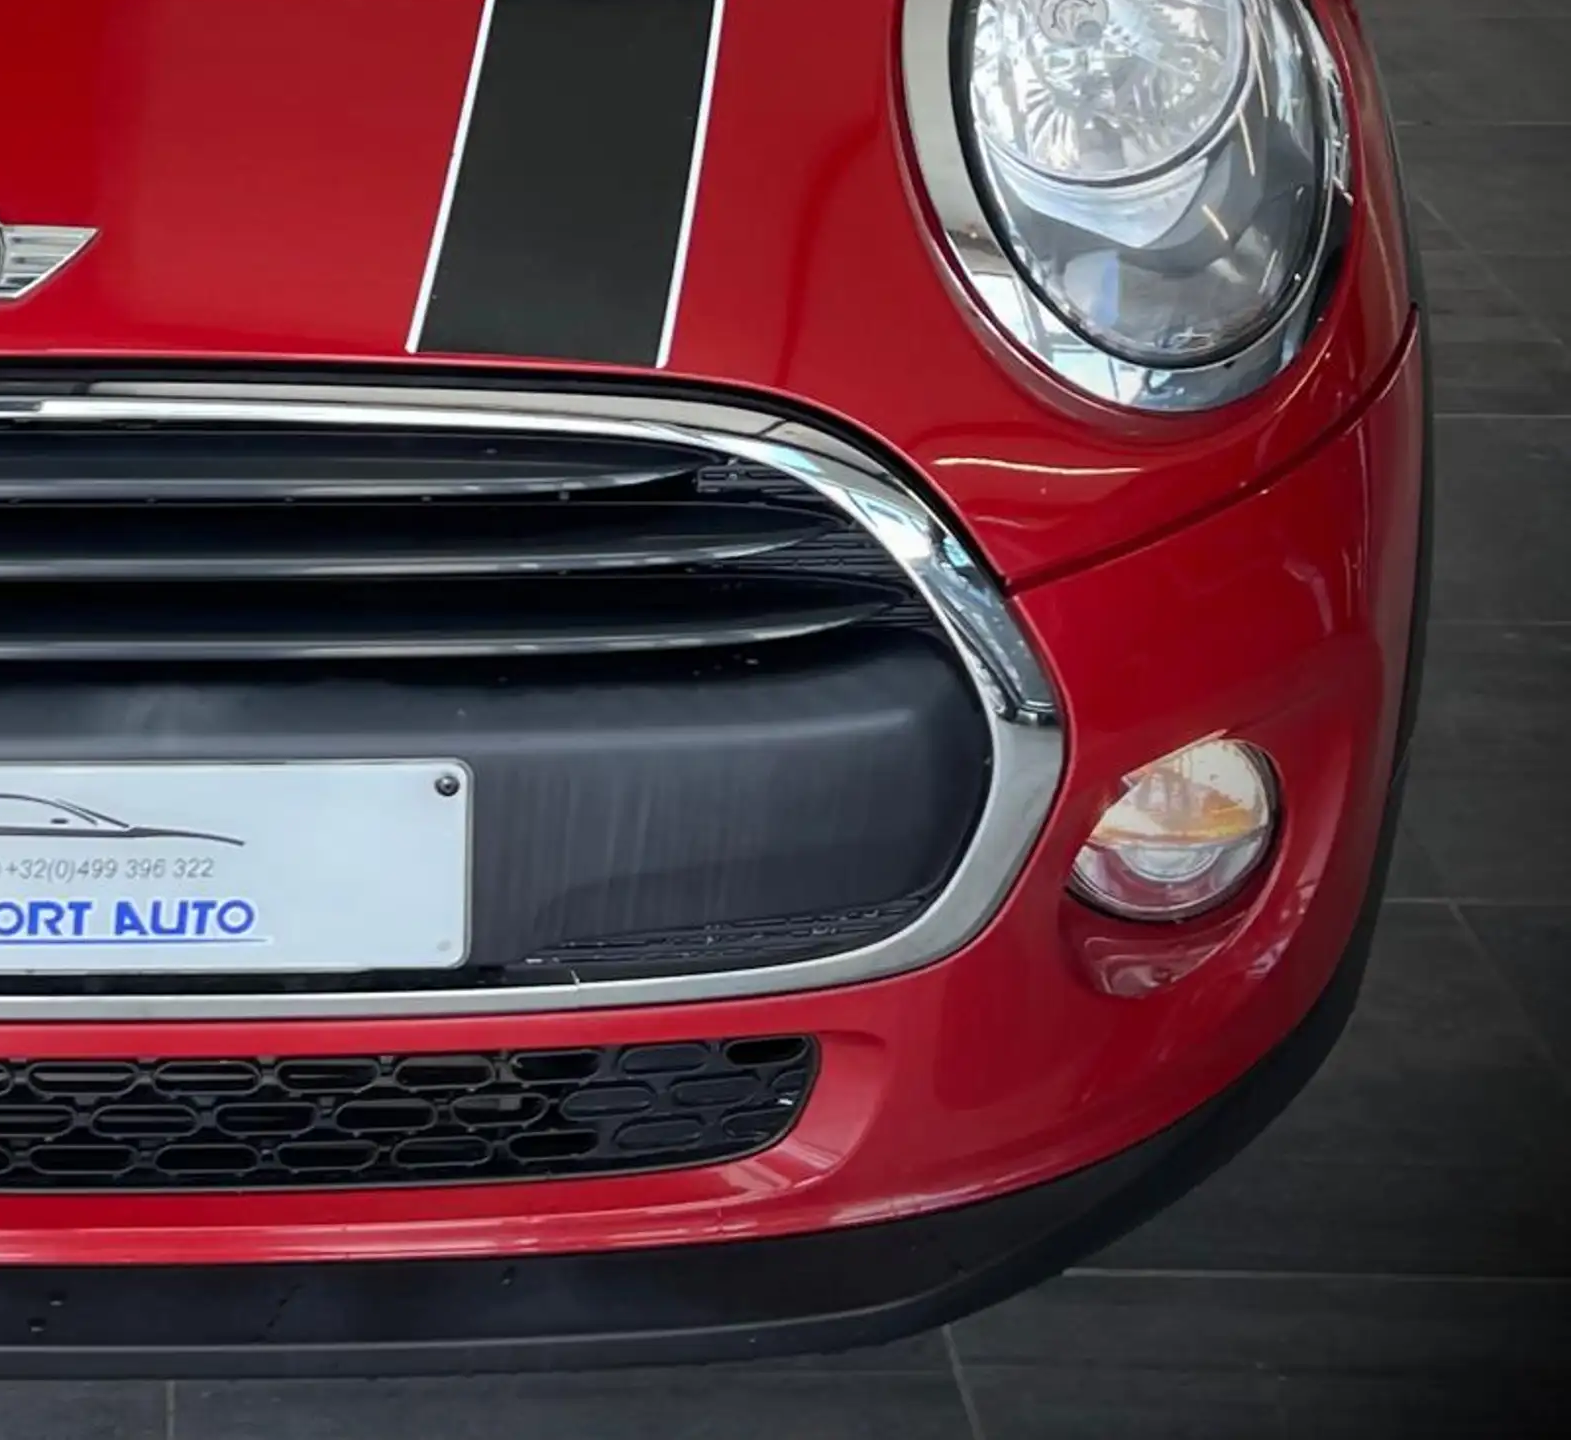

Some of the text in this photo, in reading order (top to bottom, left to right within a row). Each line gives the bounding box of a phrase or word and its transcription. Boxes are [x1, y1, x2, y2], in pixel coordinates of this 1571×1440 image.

[4, 857, 119, 883] +32(0)499
[172, 857, 215, 879] 322
[114, 899, 255, 936] AUTO
